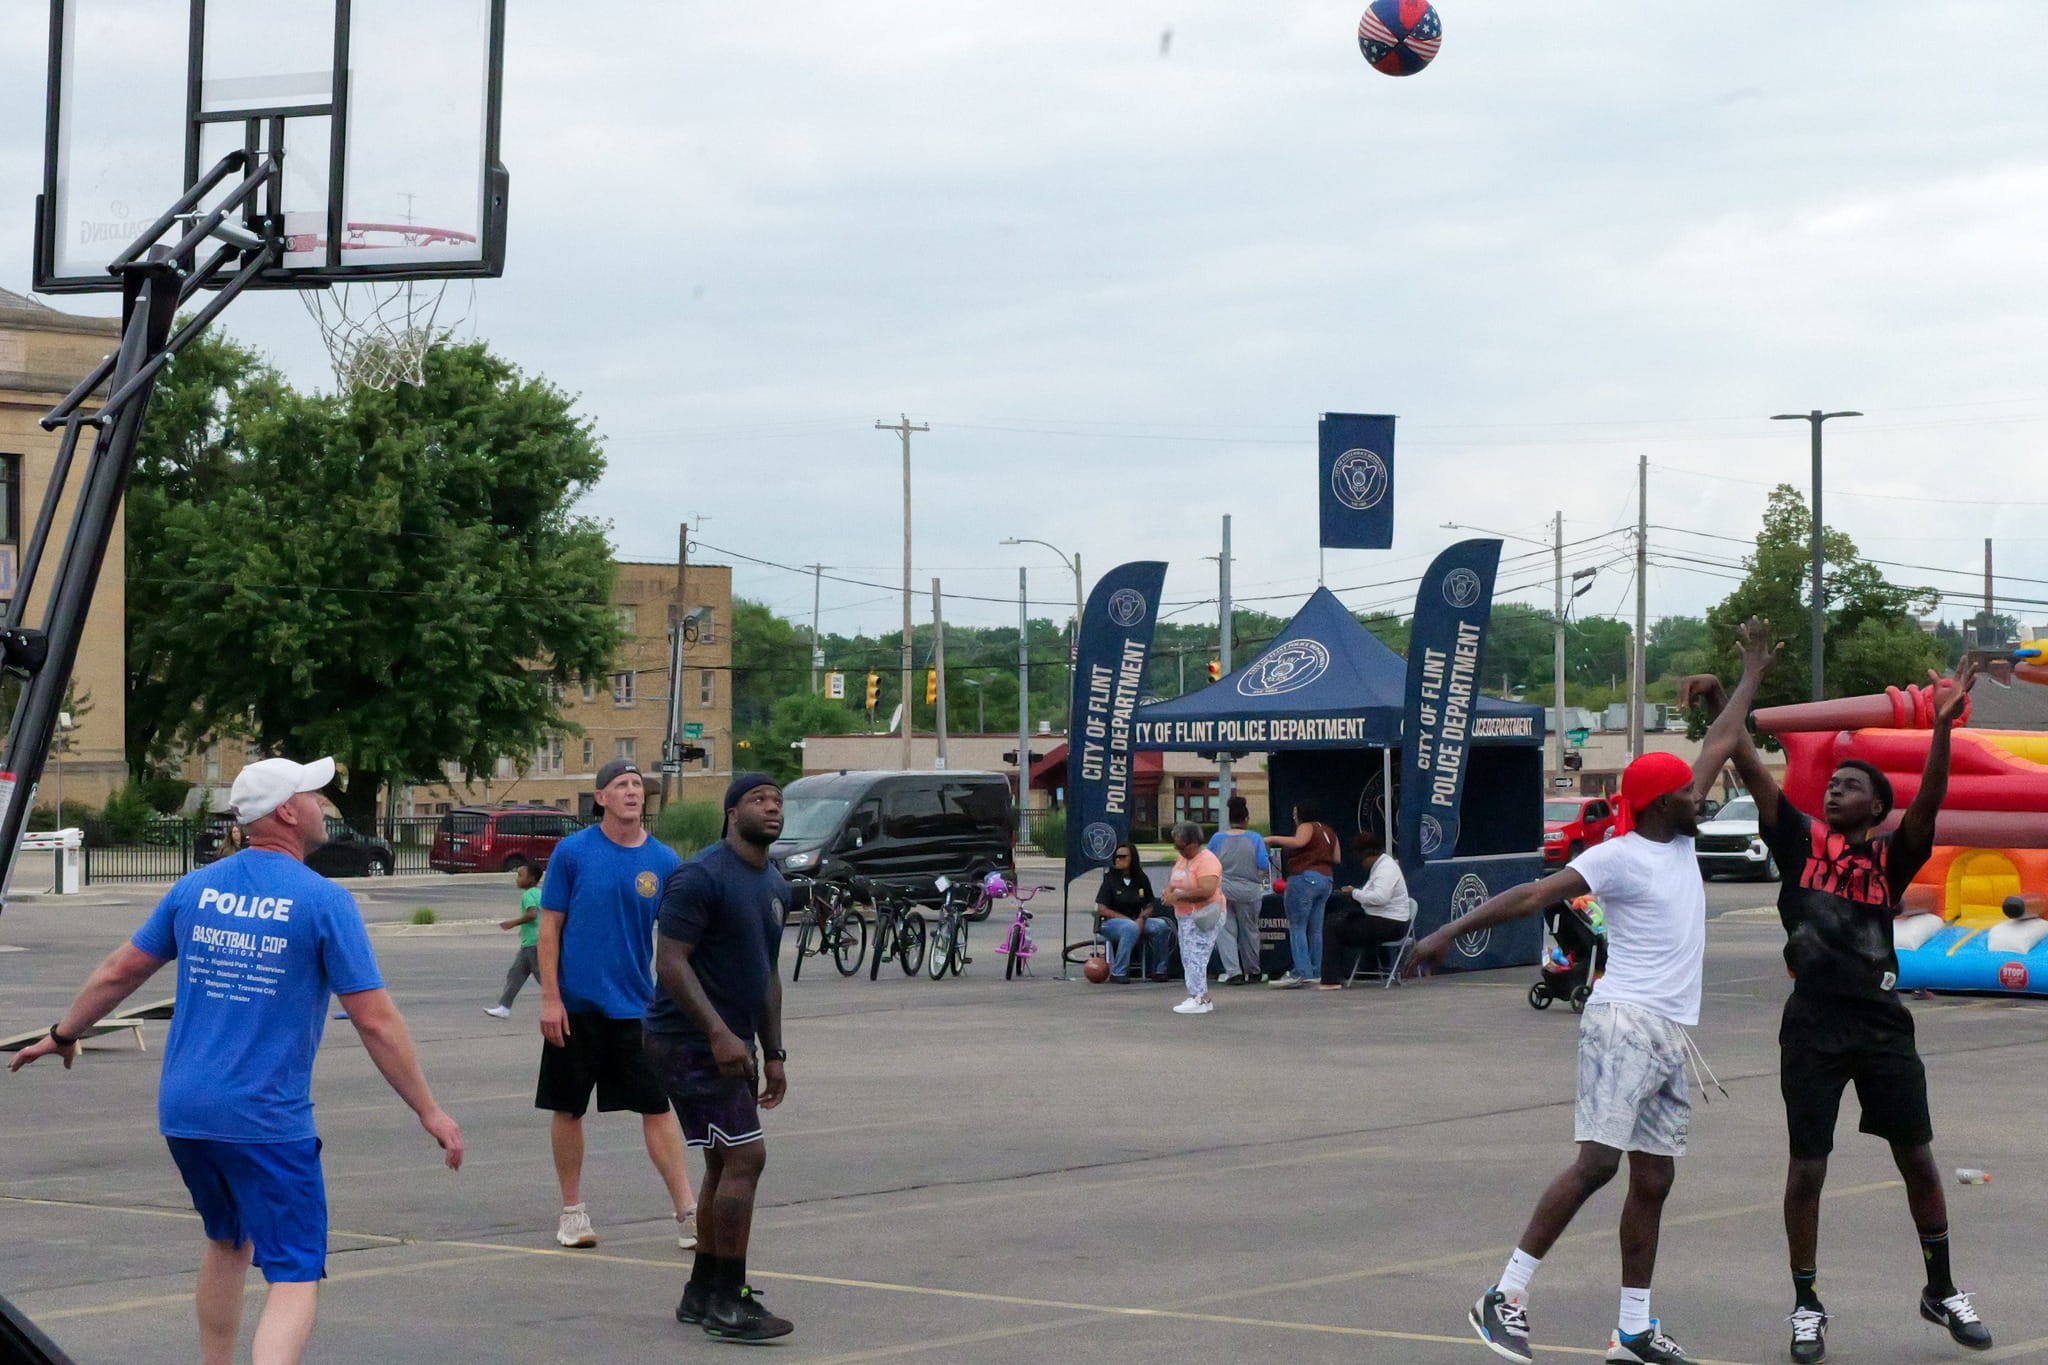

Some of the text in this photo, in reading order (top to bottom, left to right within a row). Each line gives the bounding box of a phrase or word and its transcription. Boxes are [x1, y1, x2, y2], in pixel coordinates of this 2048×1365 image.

[1110, 638, 1146, 751] DEPARTMENT
[1441, 620, 1481, 741] DEPARTMENT
[1082, 663, 1113, 781] CITY OF FLINT
[1155, 722, 1175, 743] OF
[1176, 721, 1215, 743] FLINT
[1218, 720, 1266, 742] POLICE
[1270, 718, 1366, 741] DEPARTMENT
[1417, 647, 1447, 771] CITY OF FLINT
[1105, 751, 1127, 814] POLICE
[1431, 742, 1462, 807] POLICE
[198, 887, 293, 922] POLICE
[192, 925, 288, 954] BASKETBALL COP
[208, 945, 263, 958] MICHIGAN
[234, 960, 248, 969] Park
[263, 988, 277, 996] City
